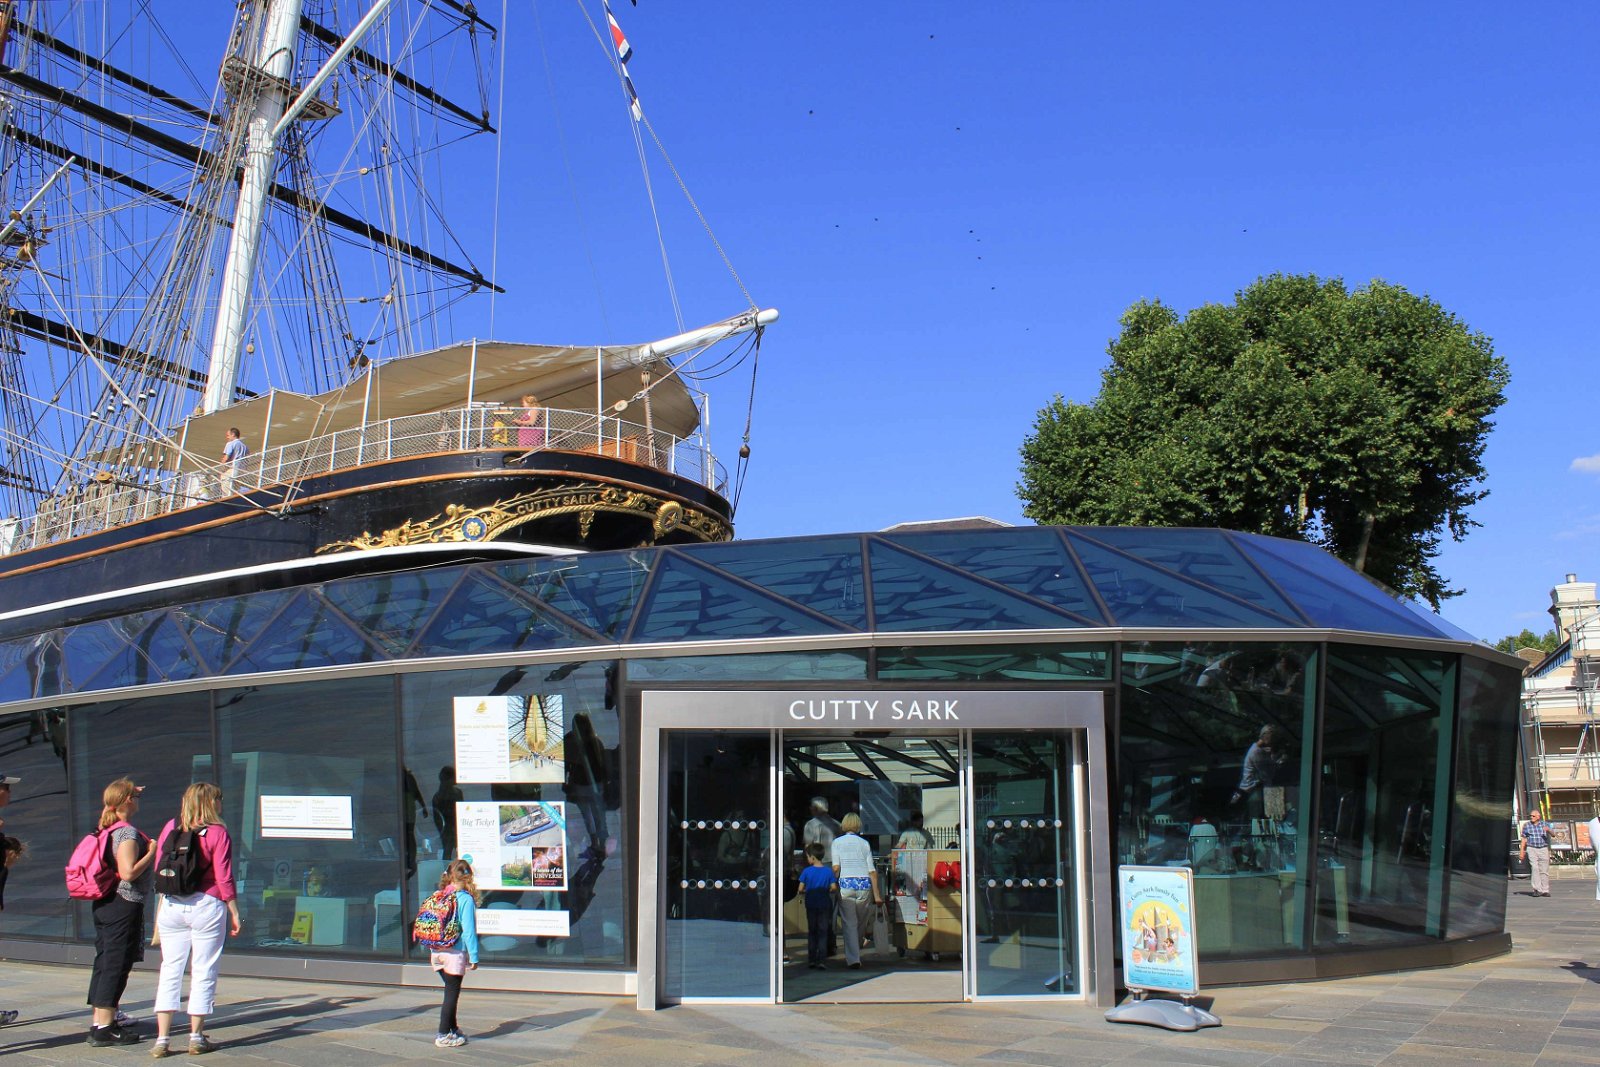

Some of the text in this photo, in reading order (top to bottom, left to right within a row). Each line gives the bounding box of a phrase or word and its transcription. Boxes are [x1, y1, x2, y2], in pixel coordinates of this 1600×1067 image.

[517, 493, 597, 515] CUTTY SARK
[789, 700, 960, 720] CUTTY SARK
[462, 818, 495, 827] Big Ticket
